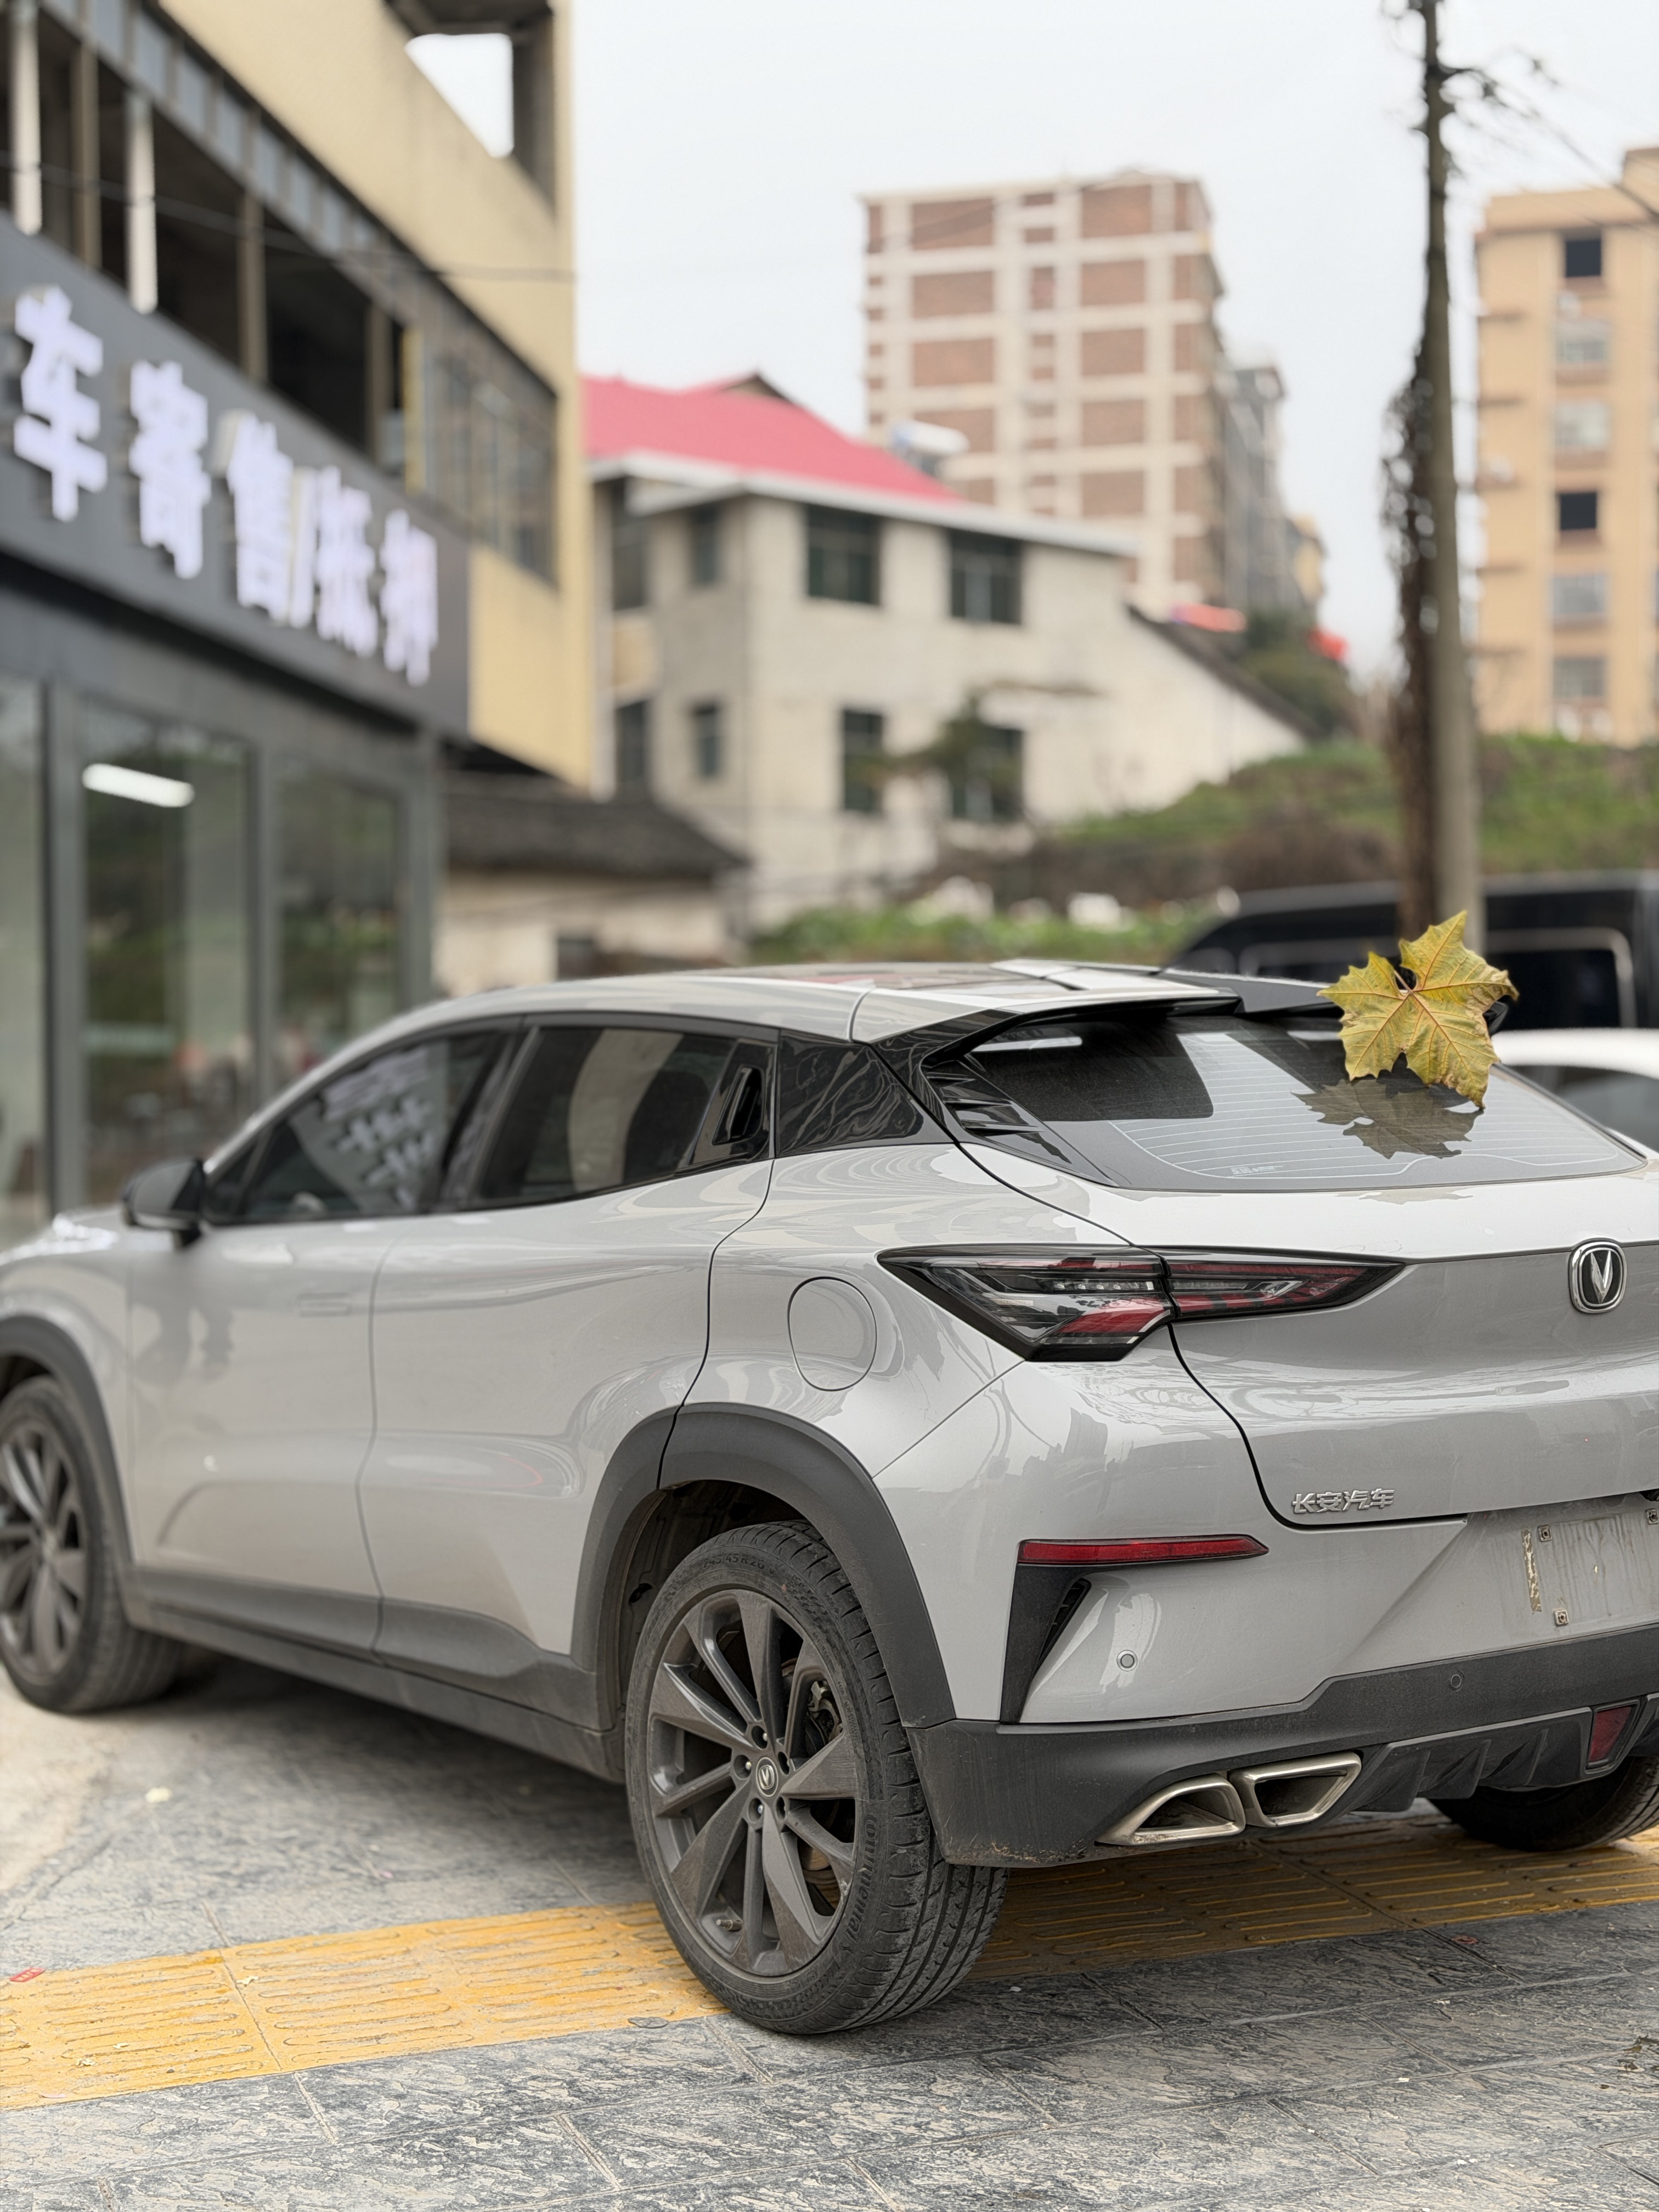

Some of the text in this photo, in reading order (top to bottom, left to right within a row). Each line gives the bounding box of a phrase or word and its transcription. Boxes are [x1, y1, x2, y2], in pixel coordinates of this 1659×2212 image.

[1292, 1488, 1395, 1514] 长安汽车
[845, 1814, 878, 1943] Continental
